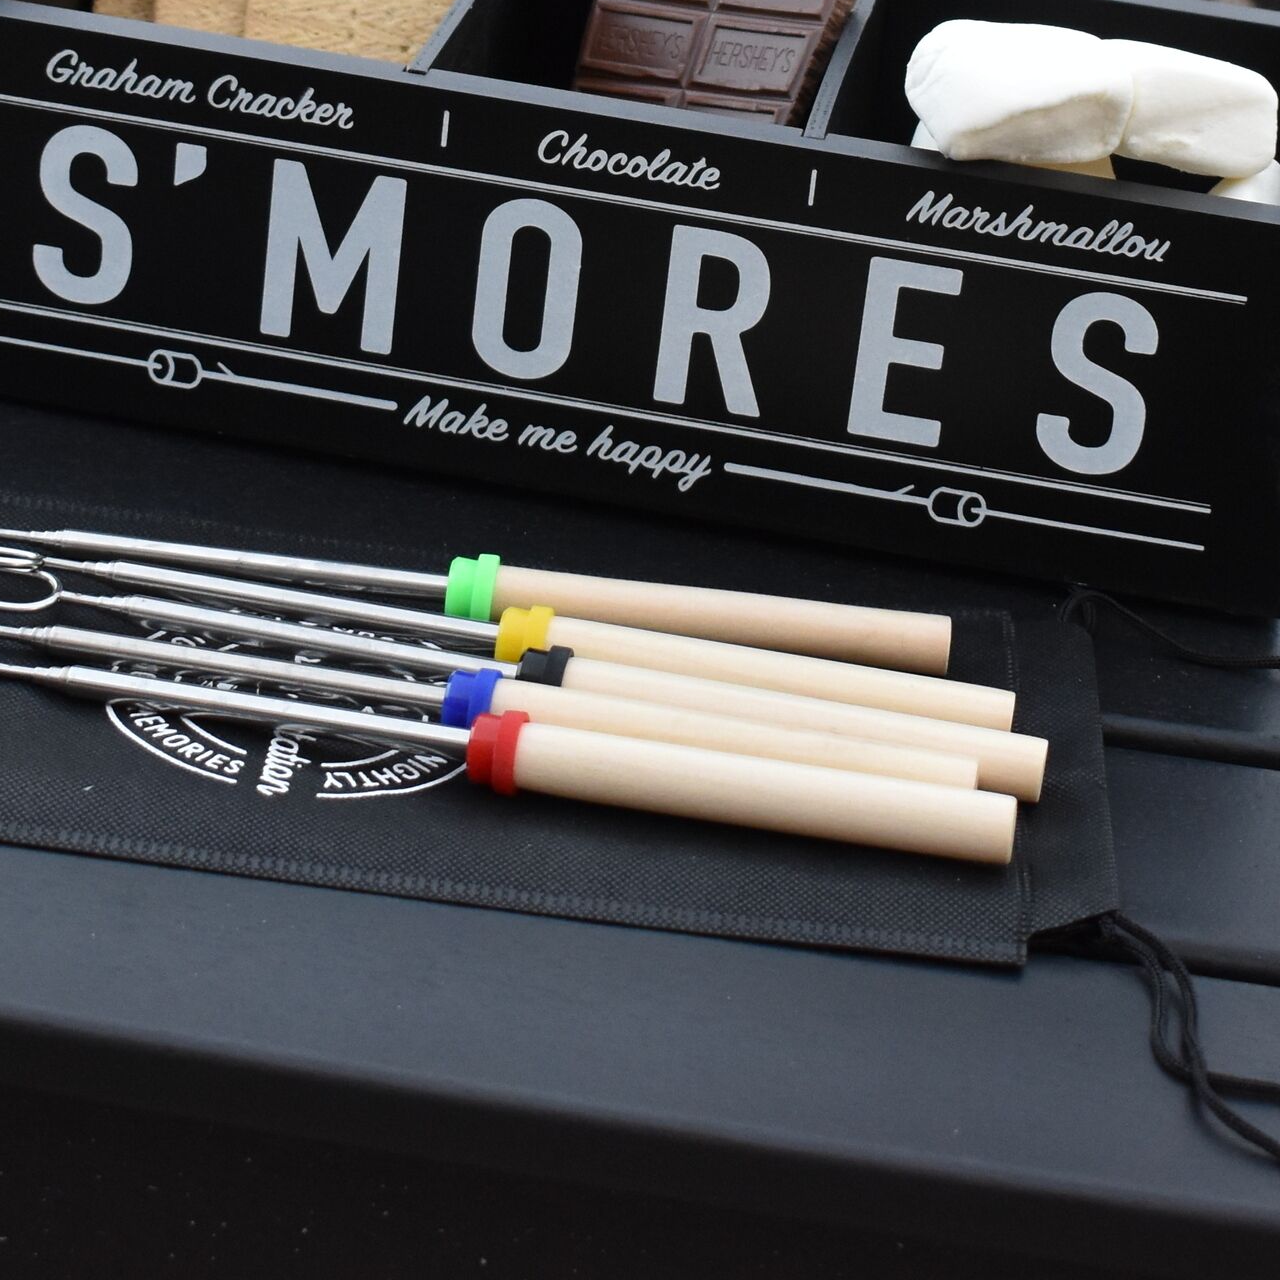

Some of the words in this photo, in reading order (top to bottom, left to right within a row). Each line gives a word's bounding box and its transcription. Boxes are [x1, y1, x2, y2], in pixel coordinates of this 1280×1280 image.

[46, 49, 196, 104] Graham
[207, 74, 354, 130] Cracker
[705, 39, 797, 74] HERSHEY'S
[537, 129, 721, 191] Chocolate
[32, 124, 1159, 475] S'MORES
[403, 395, 509, 442] Make
[517, 424, 578, 453] me
[586, 424, 712, 492] happy
[322, 753, 449, 789] NIGHTLY
